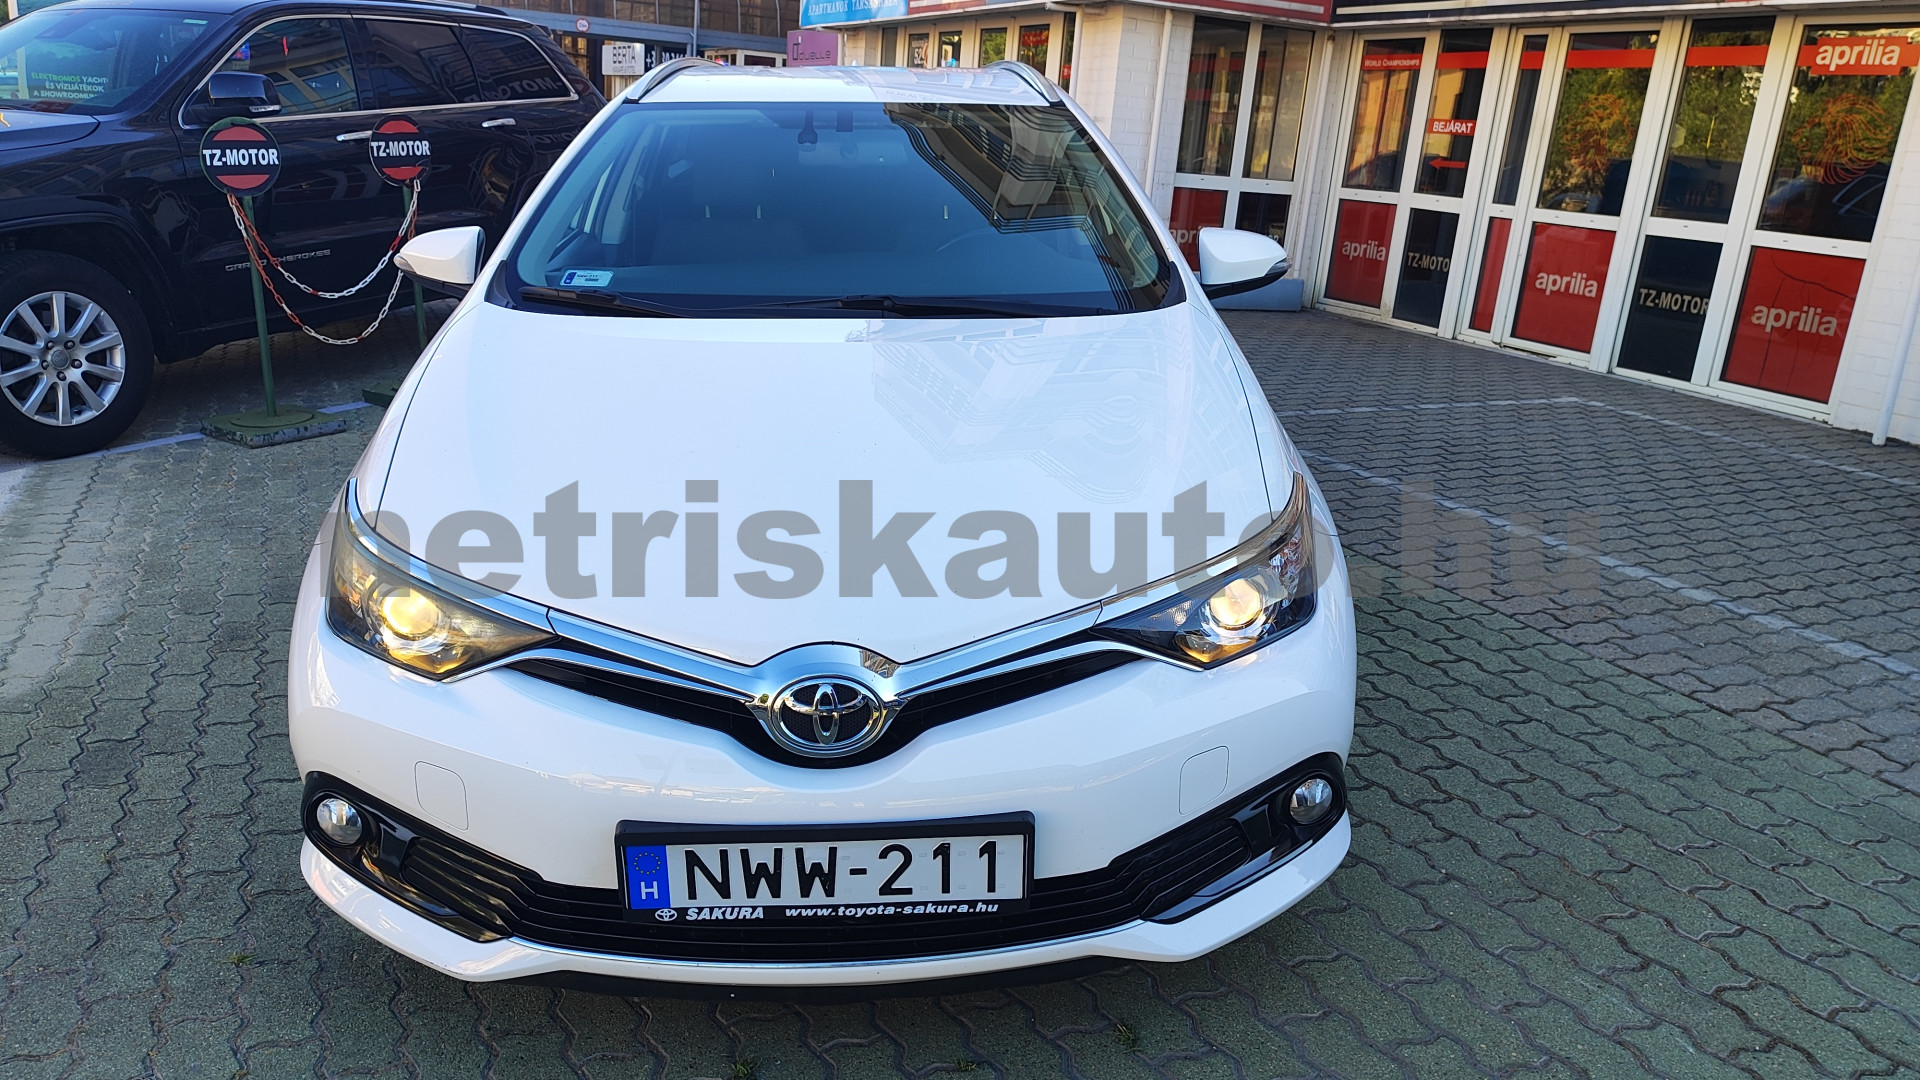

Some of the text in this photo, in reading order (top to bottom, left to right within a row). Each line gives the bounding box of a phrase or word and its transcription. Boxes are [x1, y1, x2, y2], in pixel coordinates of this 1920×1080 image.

[612, 45, 637, 64] BERTA
[1815, 39, 1900, 71] aprilia
[31, 72, 109, 84] ELEKTROMOS YACHT
[45, 80, 105, 93] ÉS VÍZIJÁTÉKOK
[1433, 119, 1474, 133] BEJÁRAT
[202, 148, 279, 166] TZ-MOTOR
[370, 140, 431, 158] TZ-MOTOR
[1341, 240, 1387, 261] aprilia
[225, 249, 332, 272] GRAD HEROKEE
[1534, 271, 1599, 299] aprilia
[1639, 288, 1711, 316] TZ-MOTOR
[1751, 305, 1838, 337] aprilia
[684, 840, 998, 900] NWW-211
[640, 881, 659, 900] H
[686, 902, 999, 920] SAKURA www.toyota-sakura.hu
